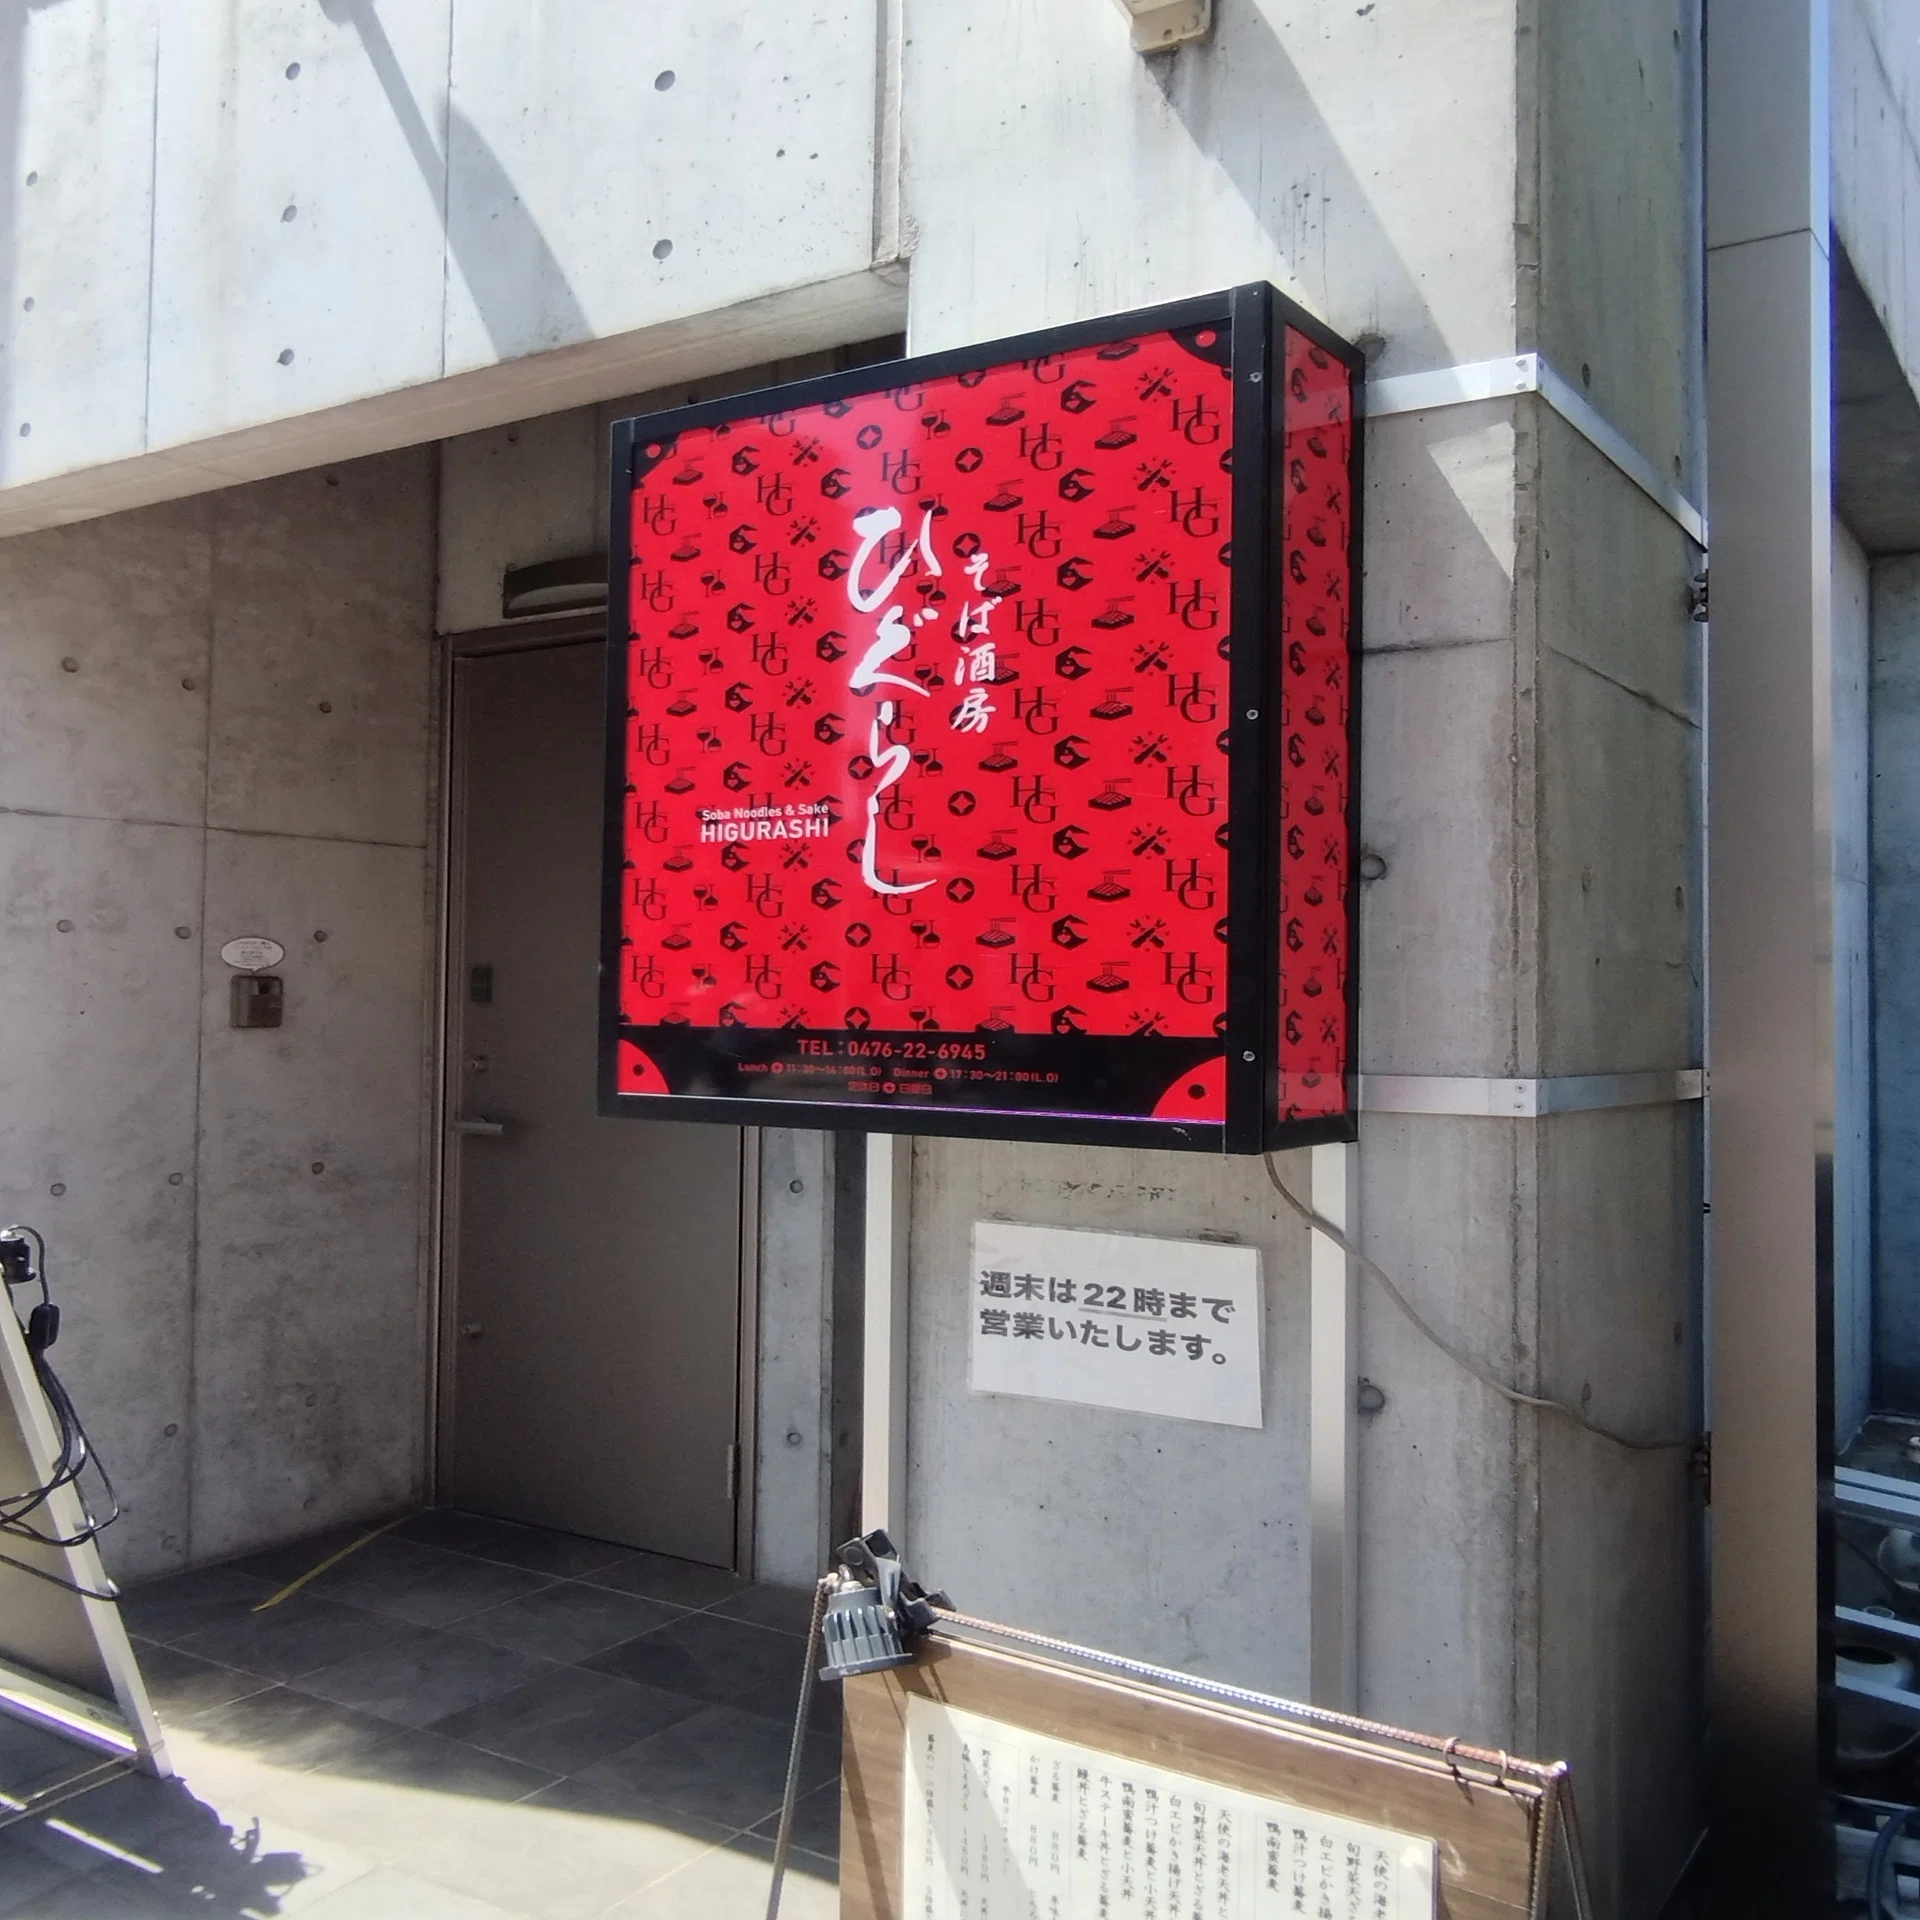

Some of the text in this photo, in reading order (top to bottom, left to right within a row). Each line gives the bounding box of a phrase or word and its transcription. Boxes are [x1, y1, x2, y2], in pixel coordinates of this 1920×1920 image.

[950, 552, 1002, 734] そば酒房
[847, 507, 942, 894] ひぐらし
[701, 817, 829, 843] HIGURASHI
[702, 803, 829, 821] Soba Noodles & Sake
[738, 1062, 768, 1073] Lunch
[893, 1067, 930, 1079] Dinner
[979, 1270, 1236, 1324] 週末は22時まで
[979, 1308, 1227, 1365] 営業いたします。
